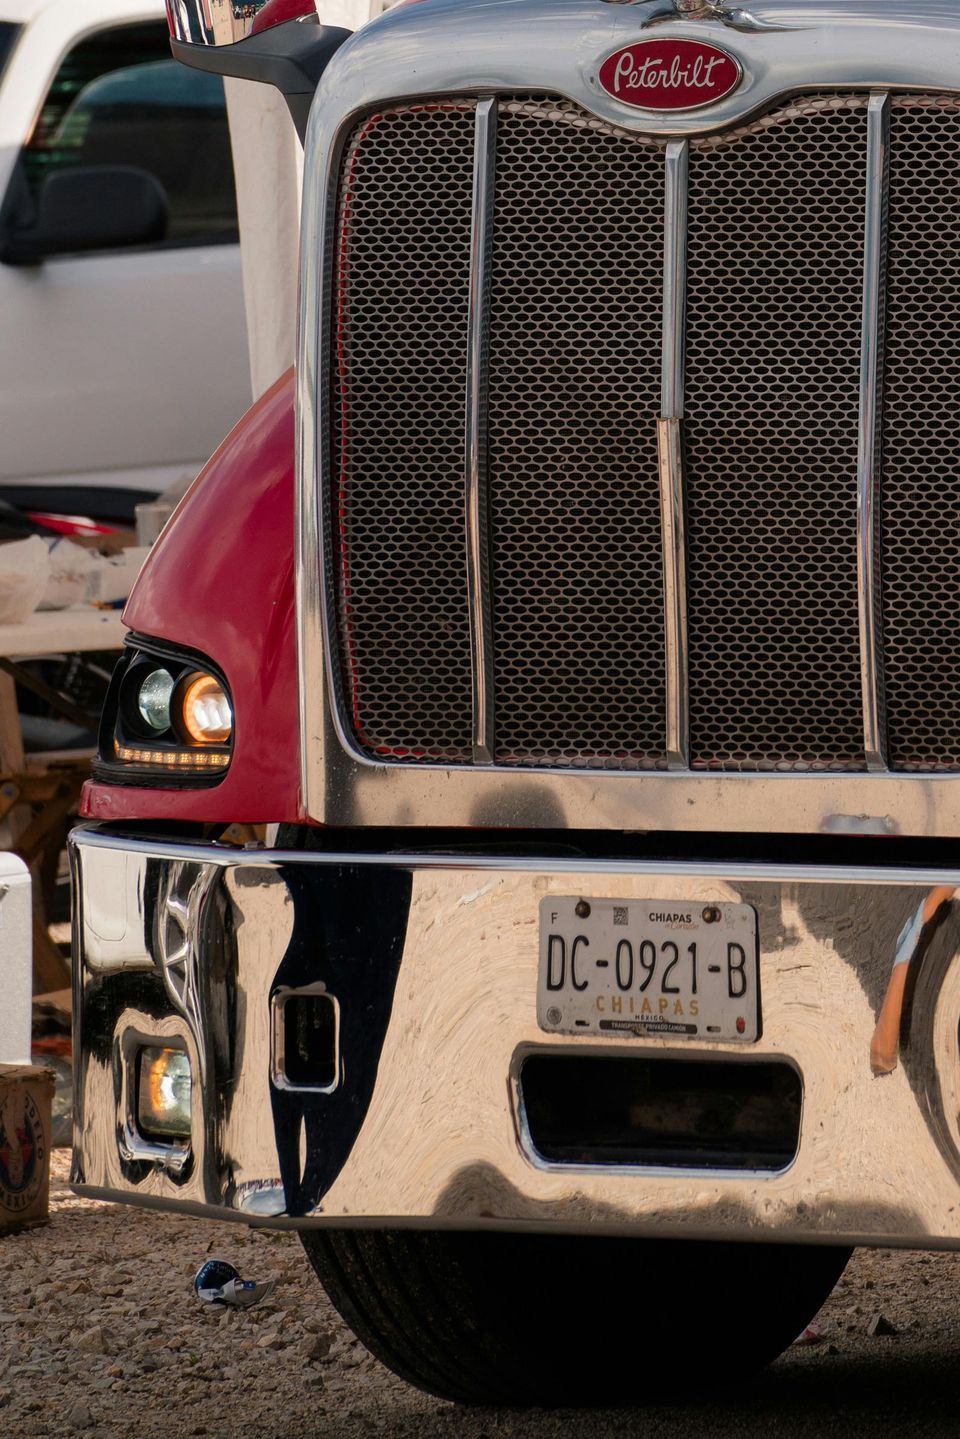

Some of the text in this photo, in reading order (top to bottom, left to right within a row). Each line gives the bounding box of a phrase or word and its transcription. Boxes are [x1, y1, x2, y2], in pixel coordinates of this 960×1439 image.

[613, 51, 726, 93] Peterbilt
[550, 912, 559, 925] F
[648, 912, 693, 924] CHIAPAS
[546, 934, 748, 998] DC-0921-B
[595, 995, 700, 1016] CHIAPAS
